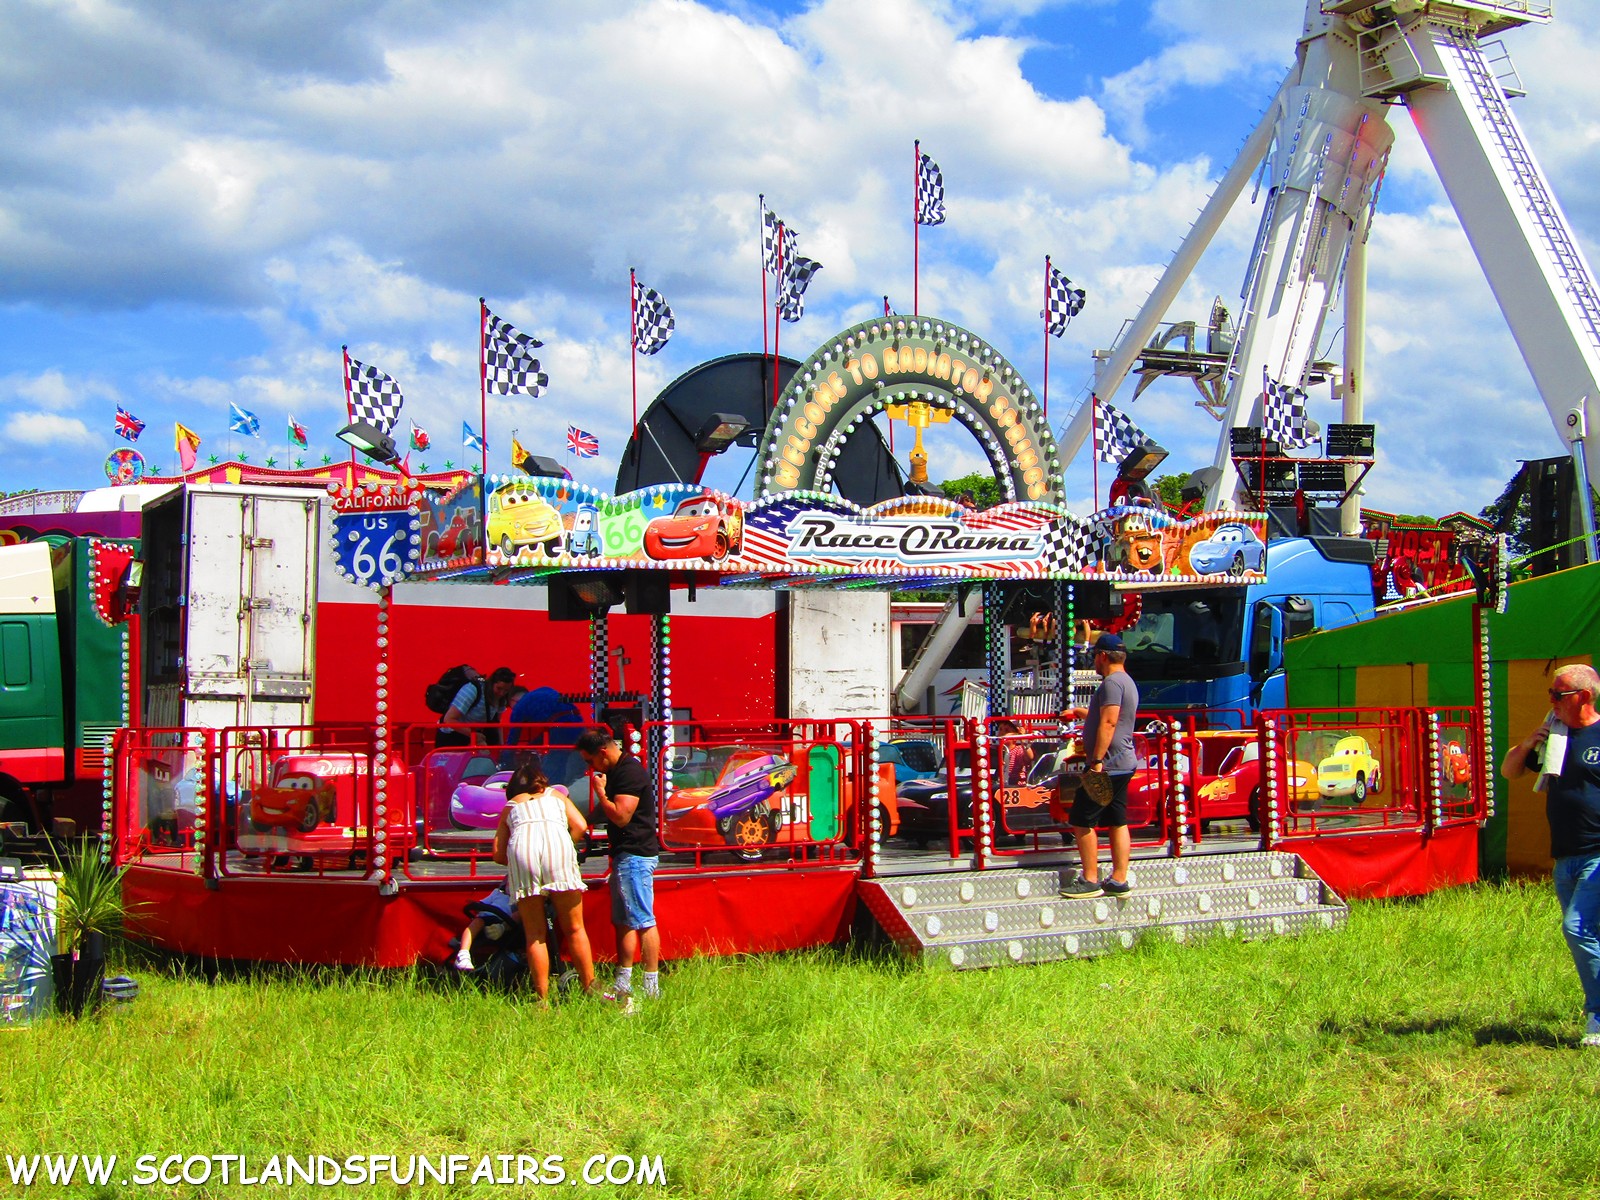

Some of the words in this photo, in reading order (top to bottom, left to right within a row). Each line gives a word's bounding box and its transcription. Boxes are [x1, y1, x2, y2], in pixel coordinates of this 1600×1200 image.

[775, 371, 848, 489] WELCOME
[845, 353, 879, 386] TO
[882, 345, 994, 403] RADIATOR
[989, 396, 1048, 500] SPRINGS
[814, 429, 841, 487] LIGHTYEAR
[335, 494, 417, 509] CALIFORNIA
[363, 517, 389, 531] US
[605, 515, 643, 550] 66
[352, 535, 402, 579] 66
[1003, 789, 1020, 805] 28
